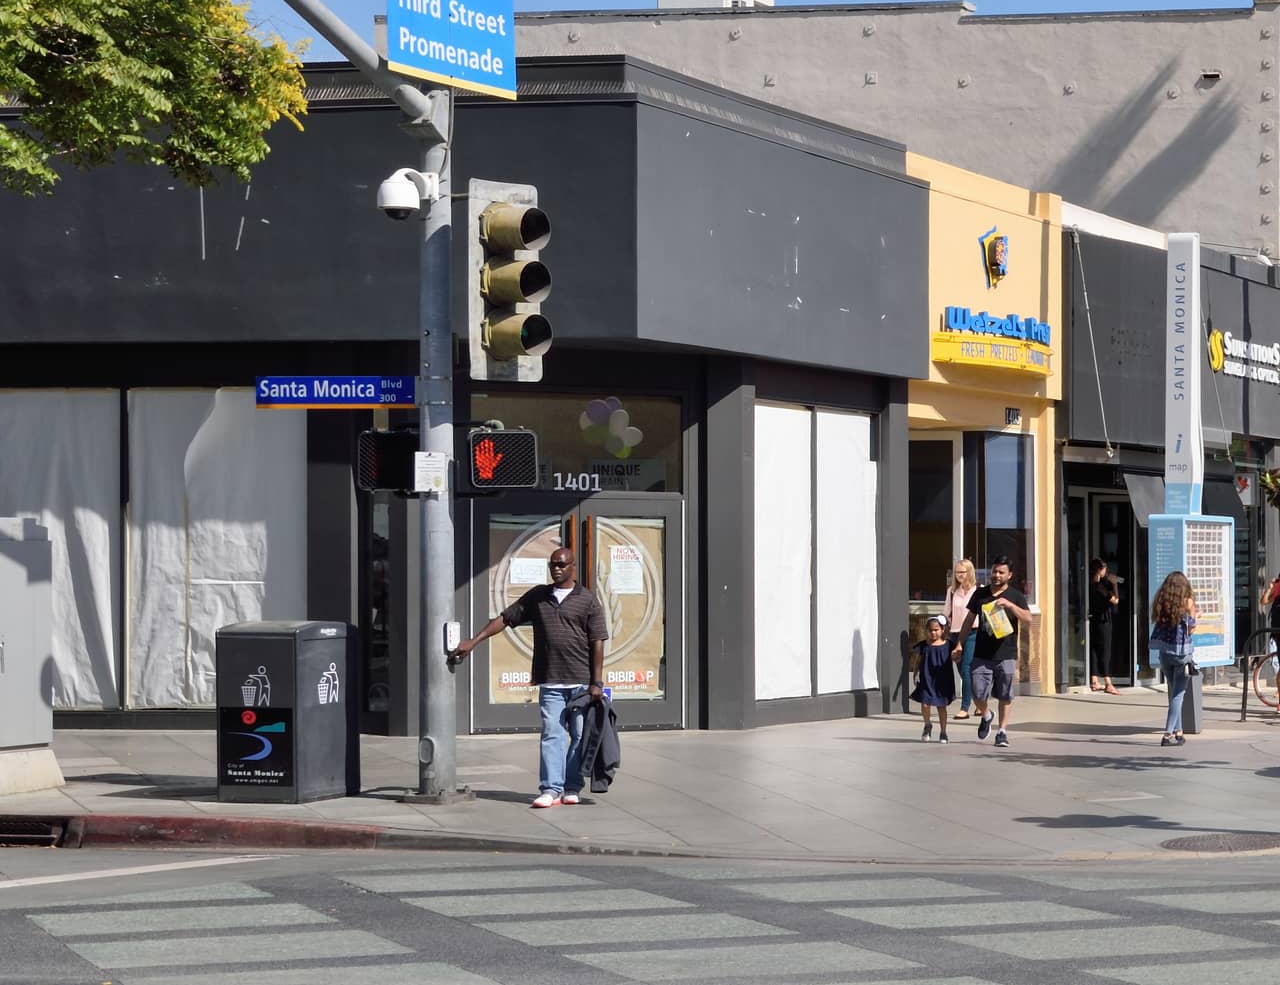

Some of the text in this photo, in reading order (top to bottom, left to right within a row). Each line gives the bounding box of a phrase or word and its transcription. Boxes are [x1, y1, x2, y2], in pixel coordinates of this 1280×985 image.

[448, 0, 506, 36] Street
[399, 26, 504, 75] Promenade
[1174, 262, 1186, 401] SANTA MONICA
[961, 342, 985, 358] FRESH
[260, 380, 375, 398] Santa Monica
[381, 379, 402, 389] Blvd
[379, 393, 396, 403] 300
[592, 463, 641, 476] UNIQUE
[1168, 463, 1188, 473] map
[553, 472, 602, 491] 1401
[501, 671, 531, 684] BIBIB
[607, 670, 655, 684] BIBIBOP
[254, 769, 284, 777] Monica
